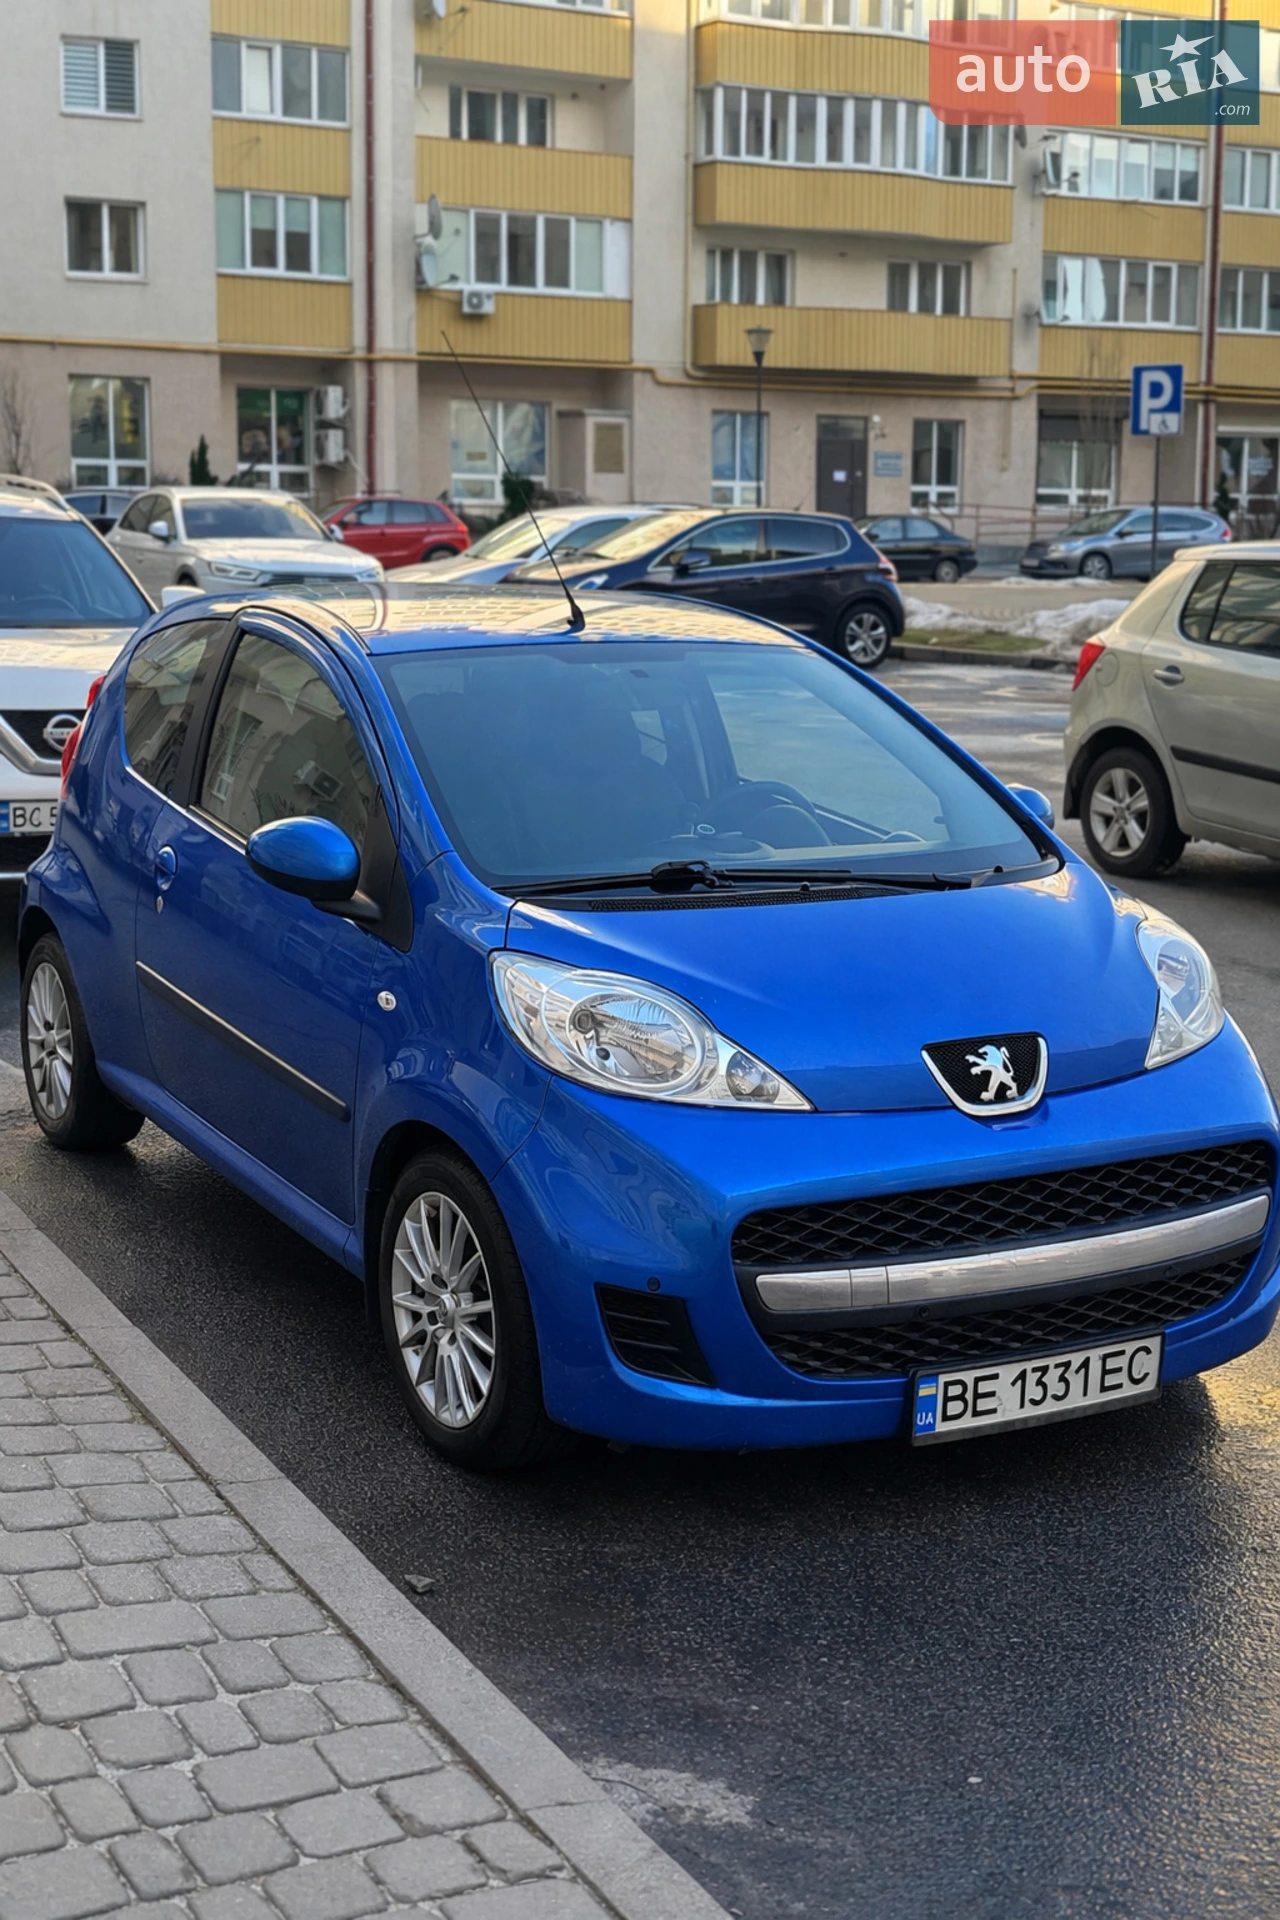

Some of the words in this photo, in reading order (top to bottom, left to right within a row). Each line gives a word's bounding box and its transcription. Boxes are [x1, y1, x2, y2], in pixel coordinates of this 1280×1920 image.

[1140, 370, 1174, 431] P
[12, 806, 42, 828] BC
[941, 1372, 1000, 1423] BE
[1010, 1355, 1091, 1410] 1331
[1099, 1344, 1153, 1394] EC
[916, 1411, 934, 1426] UA
